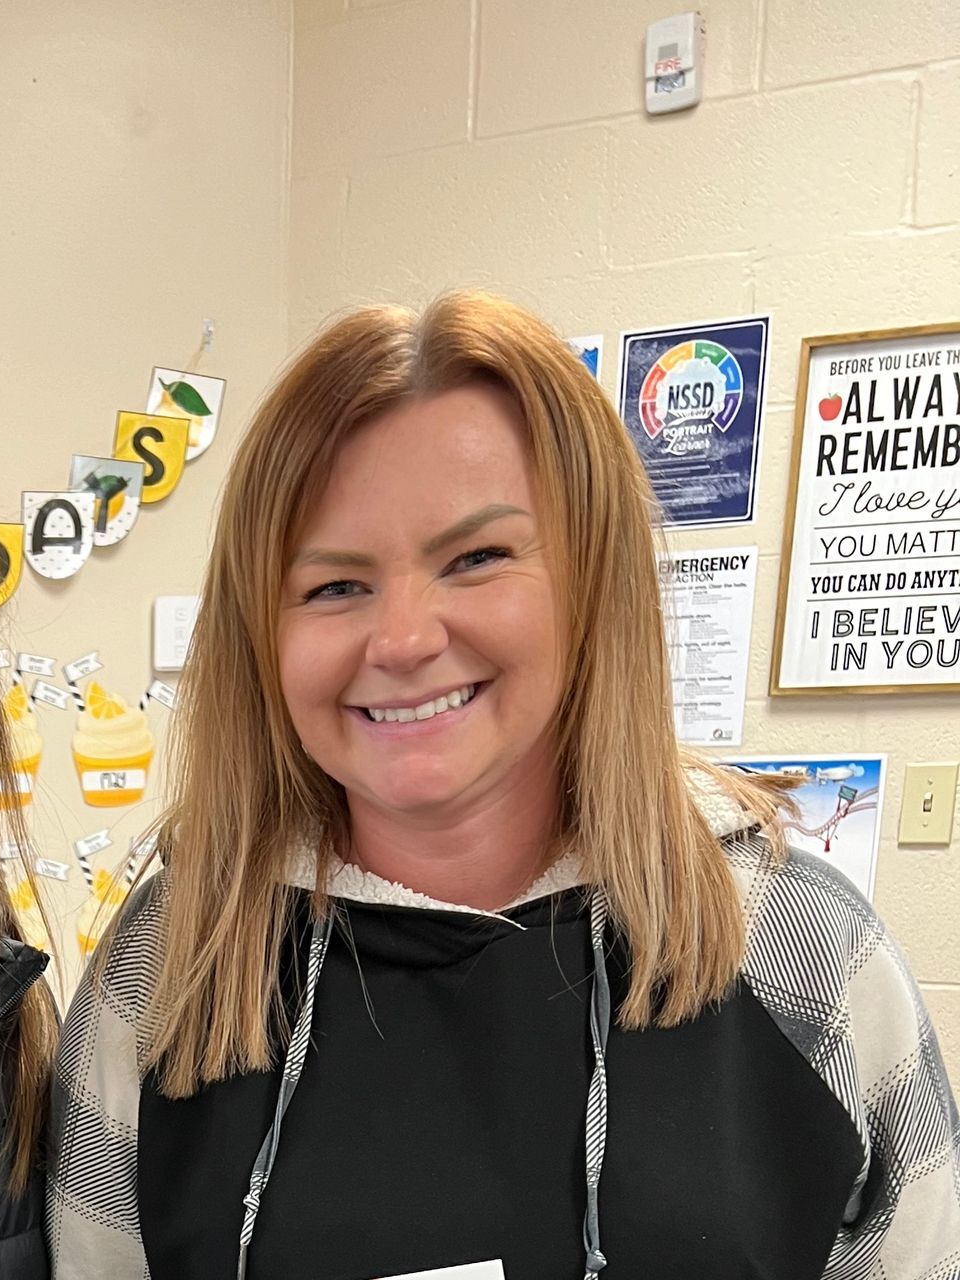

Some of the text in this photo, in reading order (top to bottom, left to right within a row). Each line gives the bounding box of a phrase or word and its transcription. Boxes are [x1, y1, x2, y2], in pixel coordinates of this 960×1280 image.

[830, 356, 874, 376] BEFORE
[878, 354, 902, 371] YOU
[905, 350, 942, 369] LEAVE
[668, 382, 714, 410] NSSD
[818, 480, 960, 519] I love y
[820, 534, 877, 559] YOU
[675, 572, 714, 584] ACTION
[811, 569, 960, 594] YOU CAN DO ANYT
[811, 611, 820, 639] I
[830, 639, 960, 671] IN YOU
